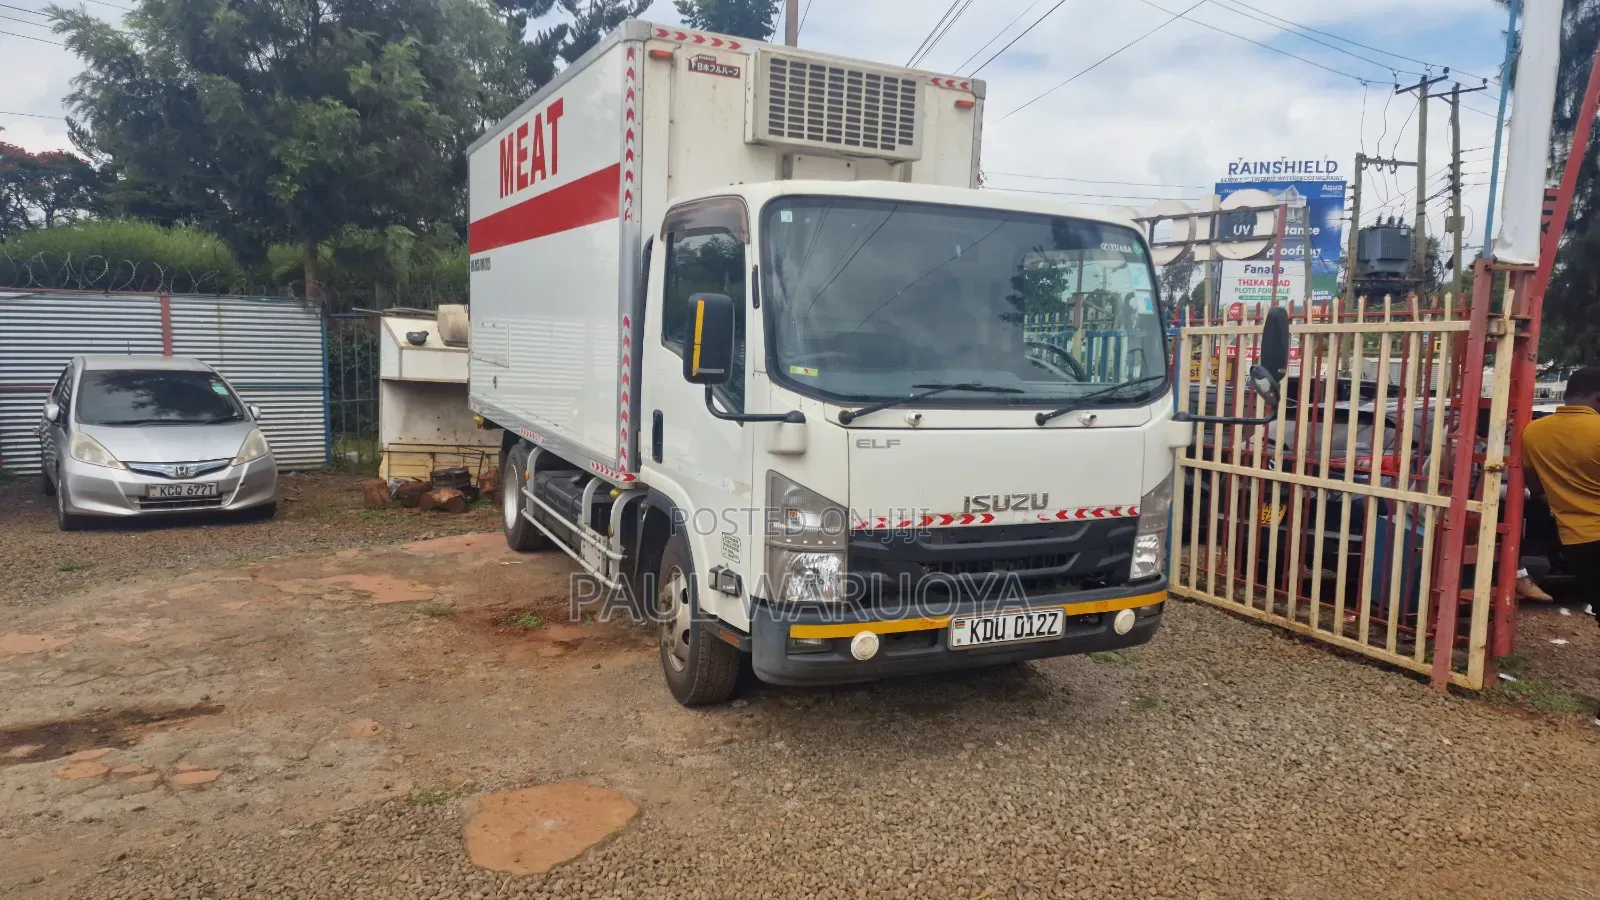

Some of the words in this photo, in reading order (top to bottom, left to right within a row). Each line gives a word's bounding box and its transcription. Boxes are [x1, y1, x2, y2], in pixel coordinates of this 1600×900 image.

[697, 62, 739, 76] 日本フルハーフ
[500, 97, 563, 199] MEAT
[1228, 160, 1338, 175] RAINSHIELD
[1321, 183, 1343, 192] Aqua
[1233, 224, 1250, 236] UV
[1110, 244, 1132, 253] YUASA
[1237, 279, 1265, 287] THIKA
[1267, 279, 1291, 287] RAD
[1275, 287, 1291, 295] ALE
[856, 439, 901, 449] ELF
[160, 486, 182, 497] KCQ
[186, 484, 214, 496] 677T
[963, 492, 1049, 514] ISUZU
[969, 616, 1006, 644] KDU
[1014, 612, 1059, 639] 012Z
